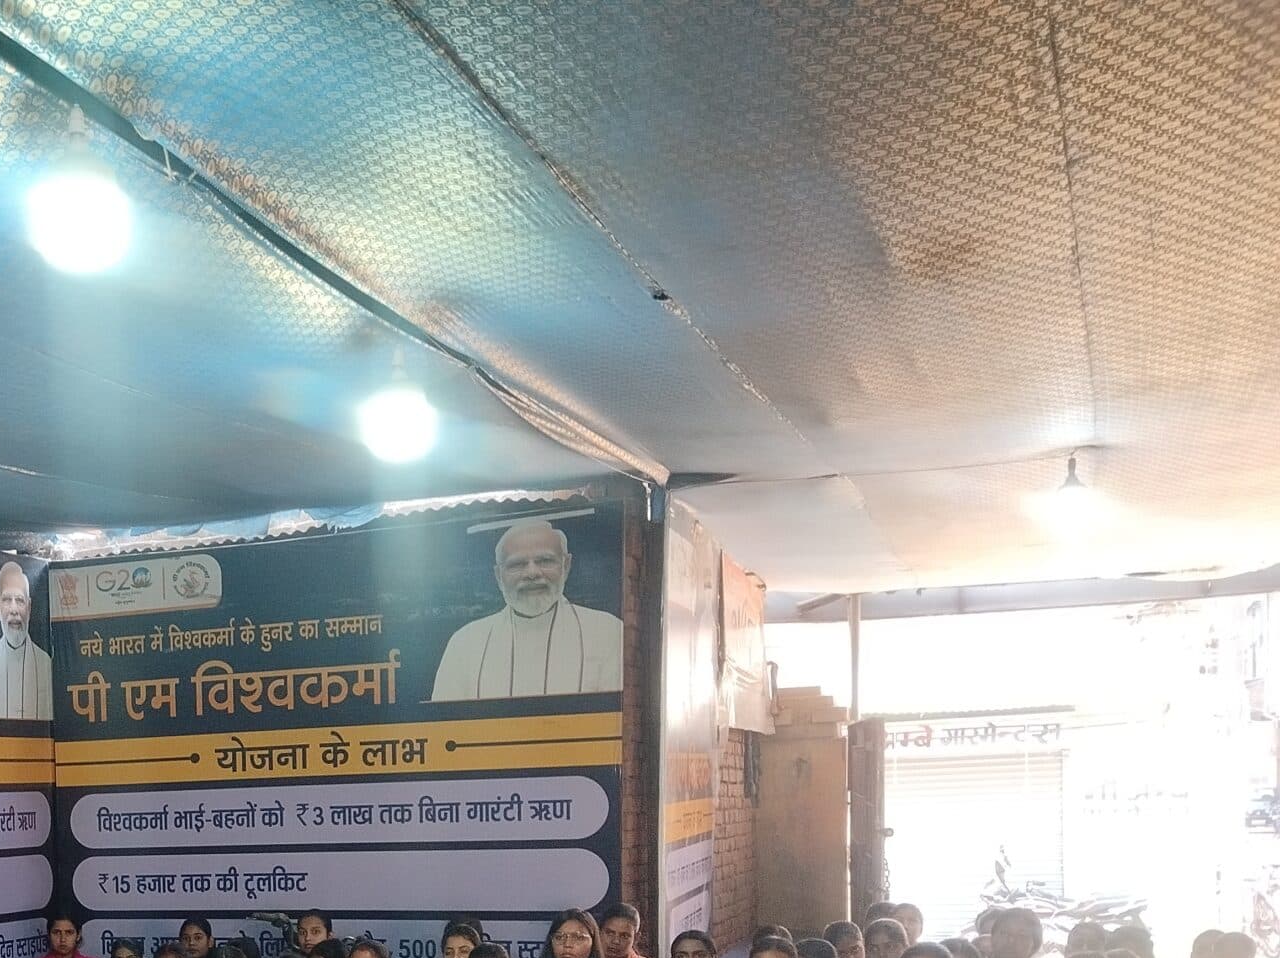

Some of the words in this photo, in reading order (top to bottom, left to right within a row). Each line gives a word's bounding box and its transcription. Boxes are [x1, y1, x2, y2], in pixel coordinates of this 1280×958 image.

[80, 630, 103, 657] नये
[109, 635, 146, 656] भारत
[150, 625, 164, 653] में
[168, 617, 236, 652] विश्वकर्मा
[239, 616, 256, 645] के
[260, 621, 294, 652] हुनर
[298, 619, 320, 640] का
[324, 614, 384, 638] सम्मान
[67, 671, 111, 723] पी
[120, 677, 179, 721] एम
[191, 648, 401, 717] विश्वकर्मा
[215, 736, 310, 773] योजना
[319, 730, 351, 768] के
[359, 738, 428, 766] लाभ
[17, 811, 36, 831] ऋण
[97, 804, 169, 832] विश्वकर्मा
[173, 801, 258, 832] भाई-बहनों
[260, 800, 285, 827] को
[329, 804, 374, 826] लाख
[378, 803, 414, 825] तक
[418, 795, 461, 824] बिना
[466, 792, 524, 823] गारंटी
[528, 799, 572, 821] ऋण
[136, 874, 177, 894] हजार
[181, 873, 212, 893] तक
[215, 866, 239, 893] की
[243, 865, 308, 900] टूलकिट
